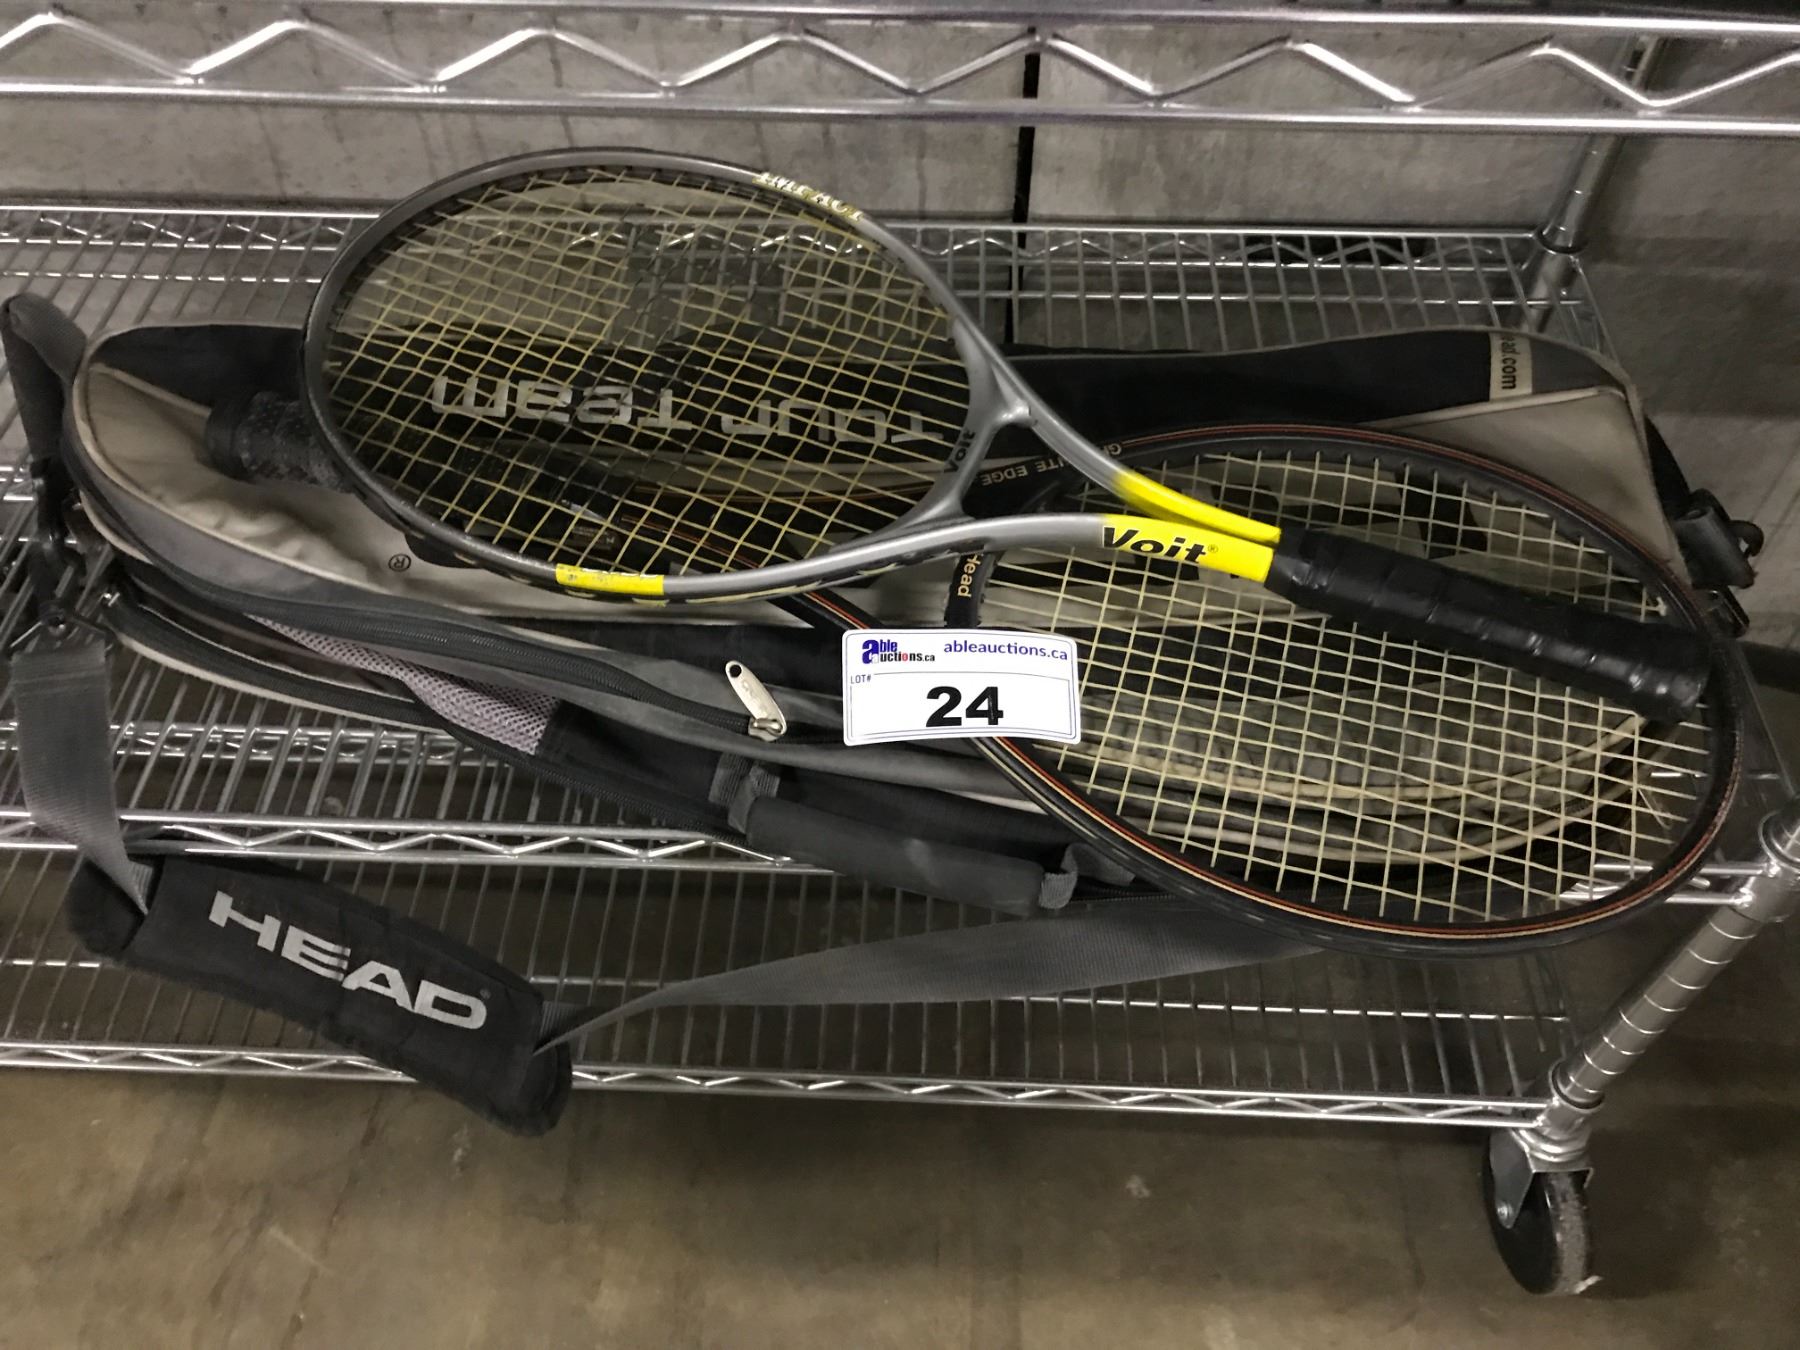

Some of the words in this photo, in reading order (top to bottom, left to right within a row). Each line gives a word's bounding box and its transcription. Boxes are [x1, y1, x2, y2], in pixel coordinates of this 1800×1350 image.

[943, 430, 976, 474] Voit
[980, 464, 1029, 487] EDGE
[957, 553, 981, 598] Head
[943, 640, 1068, 661] ableauctions.ca
[850, 674, 872, 684] LOT#
[925, 685, 1004, 727] 24
[208, 890, 488, 1030] HEAD
